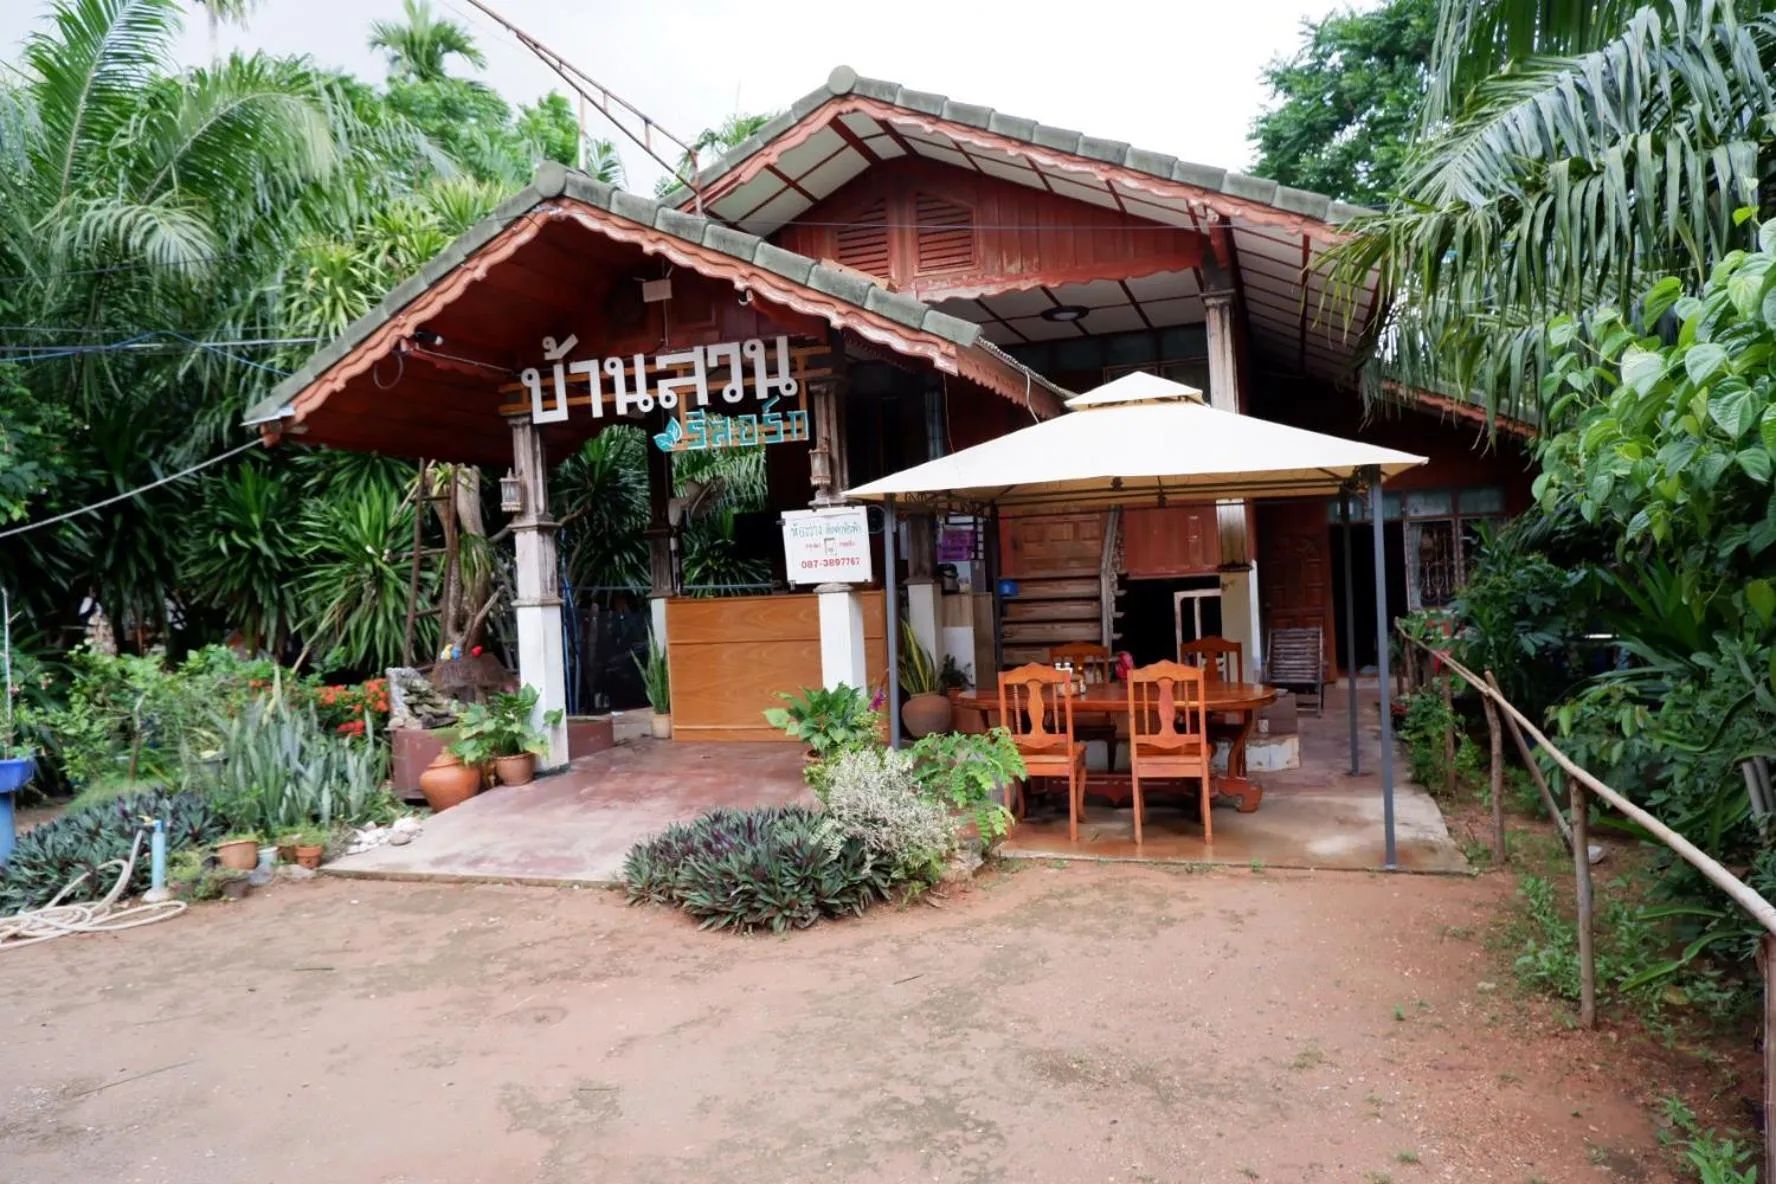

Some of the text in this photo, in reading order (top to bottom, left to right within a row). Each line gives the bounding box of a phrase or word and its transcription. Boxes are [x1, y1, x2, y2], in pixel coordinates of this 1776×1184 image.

[521, 333, 798, 425] บ้านสวน
[685, 395, 810, 450] รีสอร์ท
